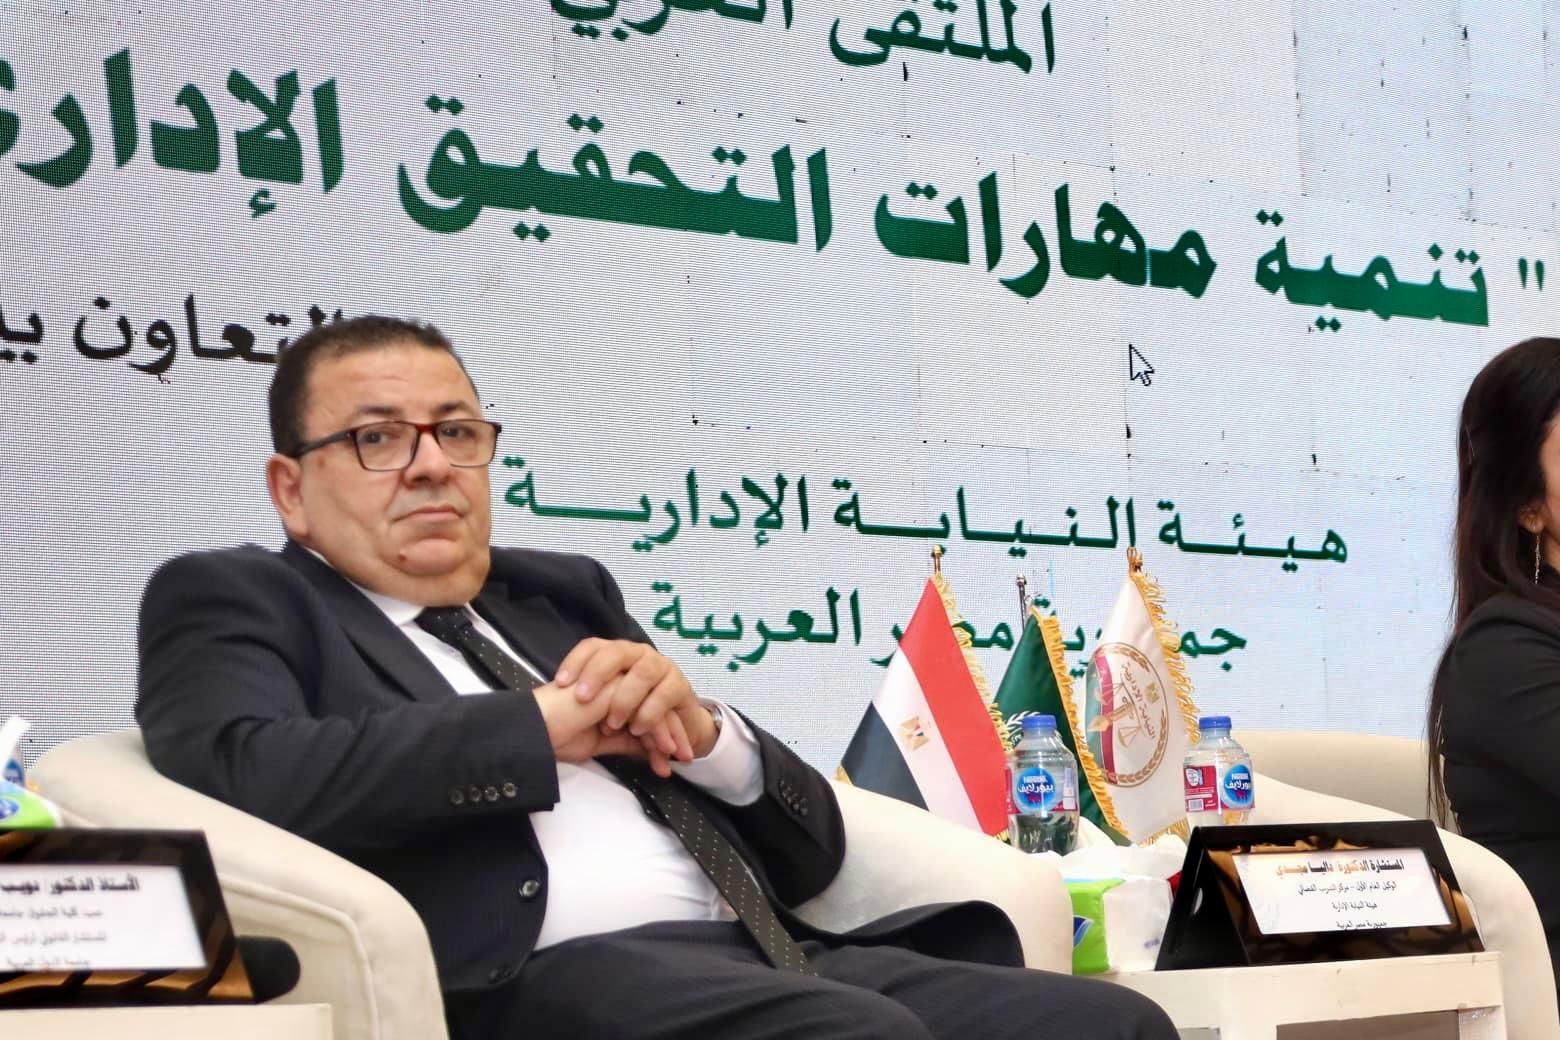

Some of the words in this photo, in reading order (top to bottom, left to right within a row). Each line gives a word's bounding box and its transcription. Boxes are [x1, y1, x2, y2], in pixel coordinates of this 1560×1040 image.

[829, 0, 1055, 74] الملتقى
[0, 47, 344, 218] الإدار
[399, 93, 834, 252] التحقيق
[874, 171, 1217, 299] مهارات
[1254, 209, 1490, 333] تنمية
[502, 456, 809, 553] الإدارية
[831, 477, 1137, 560] النيابة
[1156, 496, 1349, 573] هيئة
[650, 582, 862, 672] العربية
